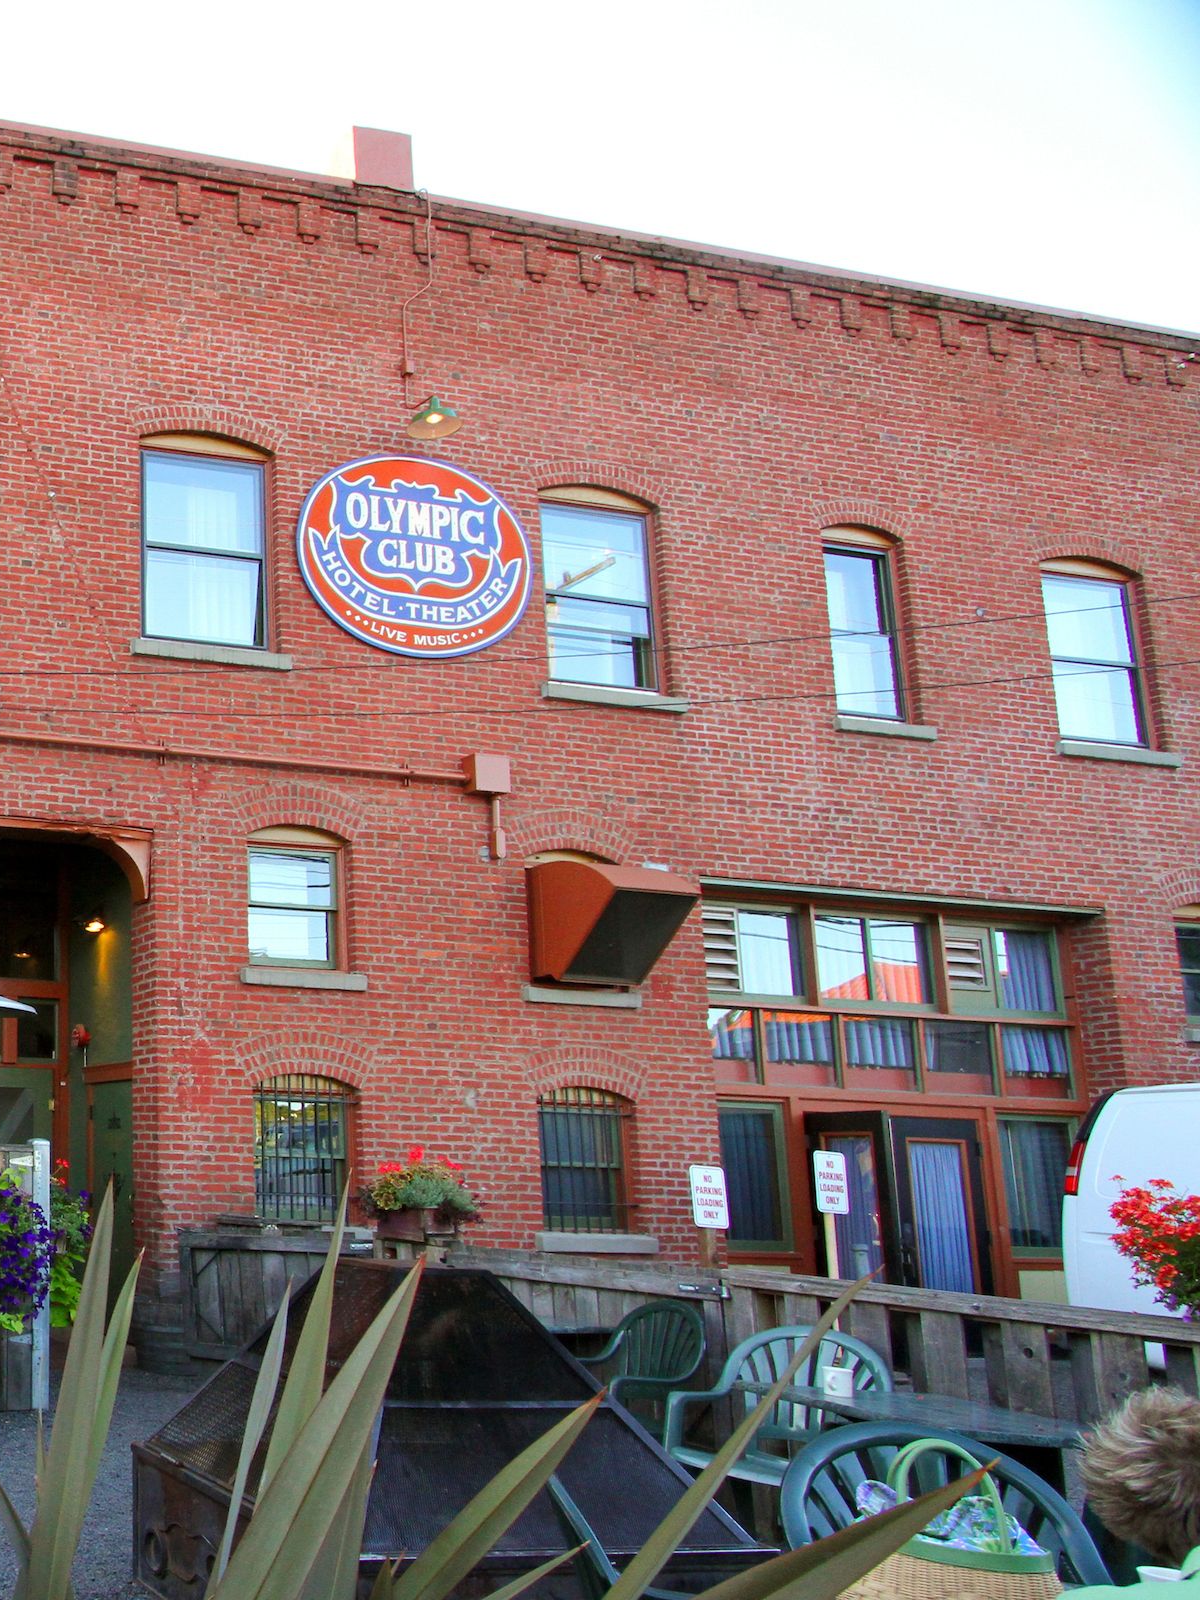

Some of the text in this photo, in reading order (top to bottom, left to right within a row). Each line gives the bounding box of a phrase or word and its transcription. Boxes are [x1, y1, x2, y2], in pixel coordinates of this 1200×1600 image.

[345, 491, 485, 546] OLYMPIC
[377, 538, 456, 576] CLUB
[322, 550, 509, 623] HOTEL THEATER
[370, 621, 462, 646] LIVE MUSIC
[826, 1160, 834, 1169] NO
[703, 1174, 712, 1183] NO
[818, 1171, 843, 1182] PARKING
[695, 1185, 723, 1197] PARKING
[819, 1183, 845, 1194] LOADING
[696, 1197, 724, 1208] LOADING
[825, 1195, 840, 1205] ONLY
[703, 1209, 719, 1219] ONLY
